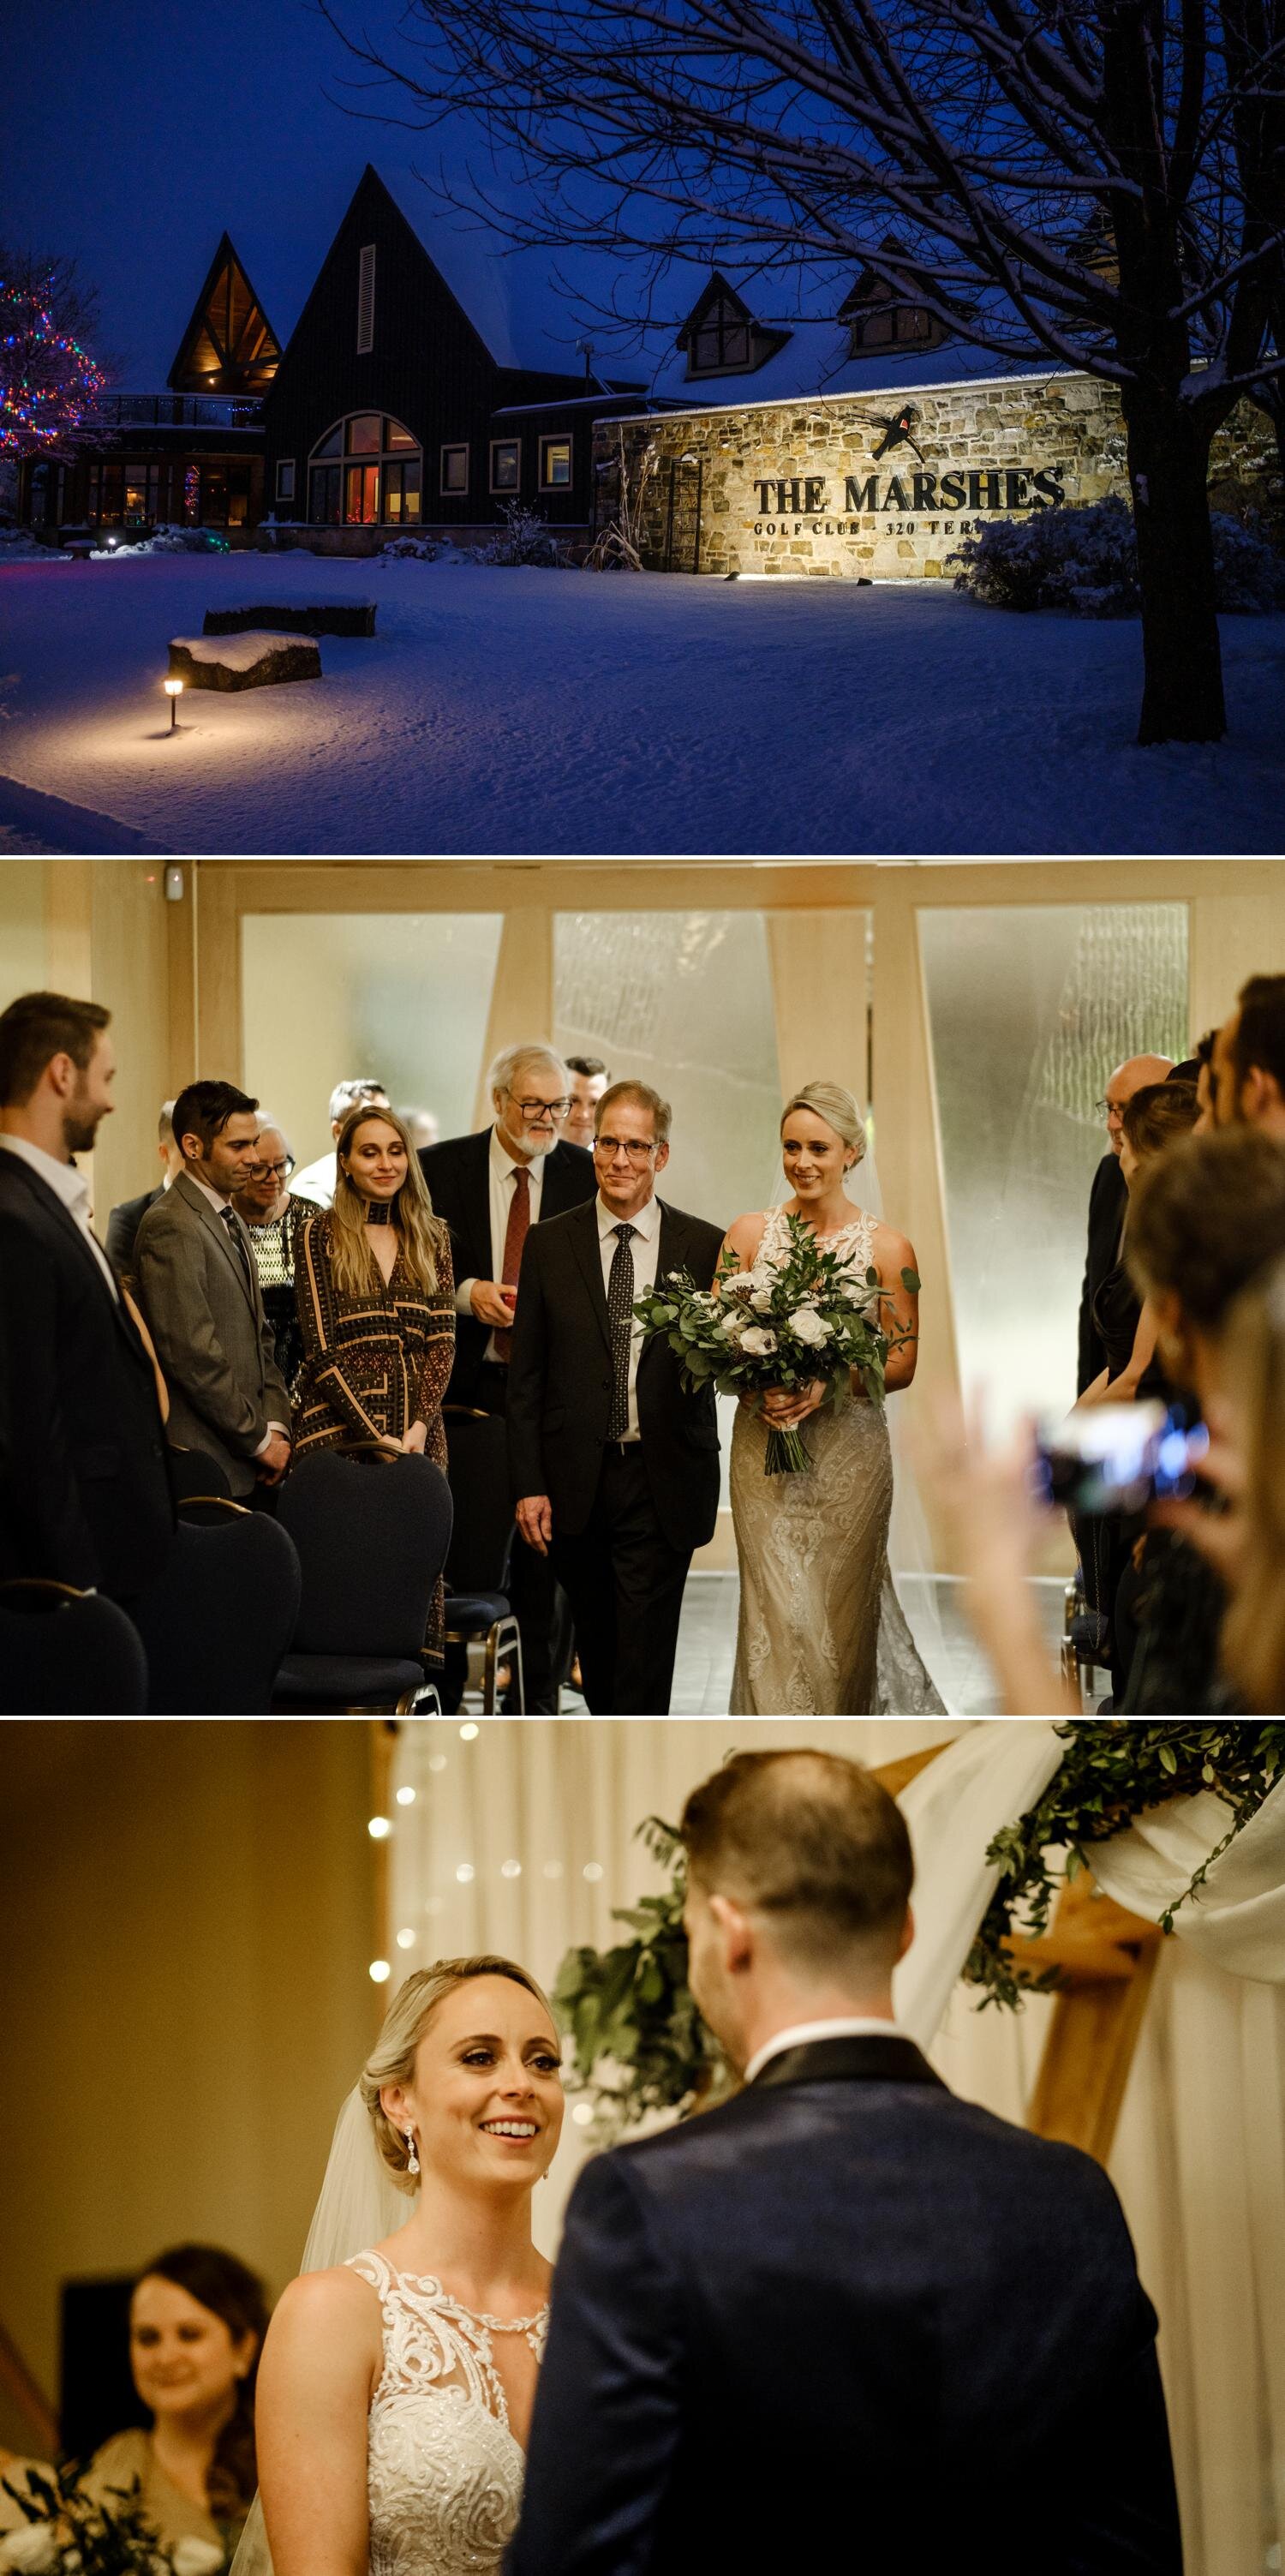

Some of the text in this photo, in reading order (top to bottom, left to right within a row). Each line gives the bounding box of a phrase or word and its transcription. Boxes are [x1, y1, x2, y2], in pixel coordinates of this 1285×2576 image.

[754, 466, 1066, 514] THE MARSHES
[754, 520, 981, 536] GOLF CLUB 320 TER
